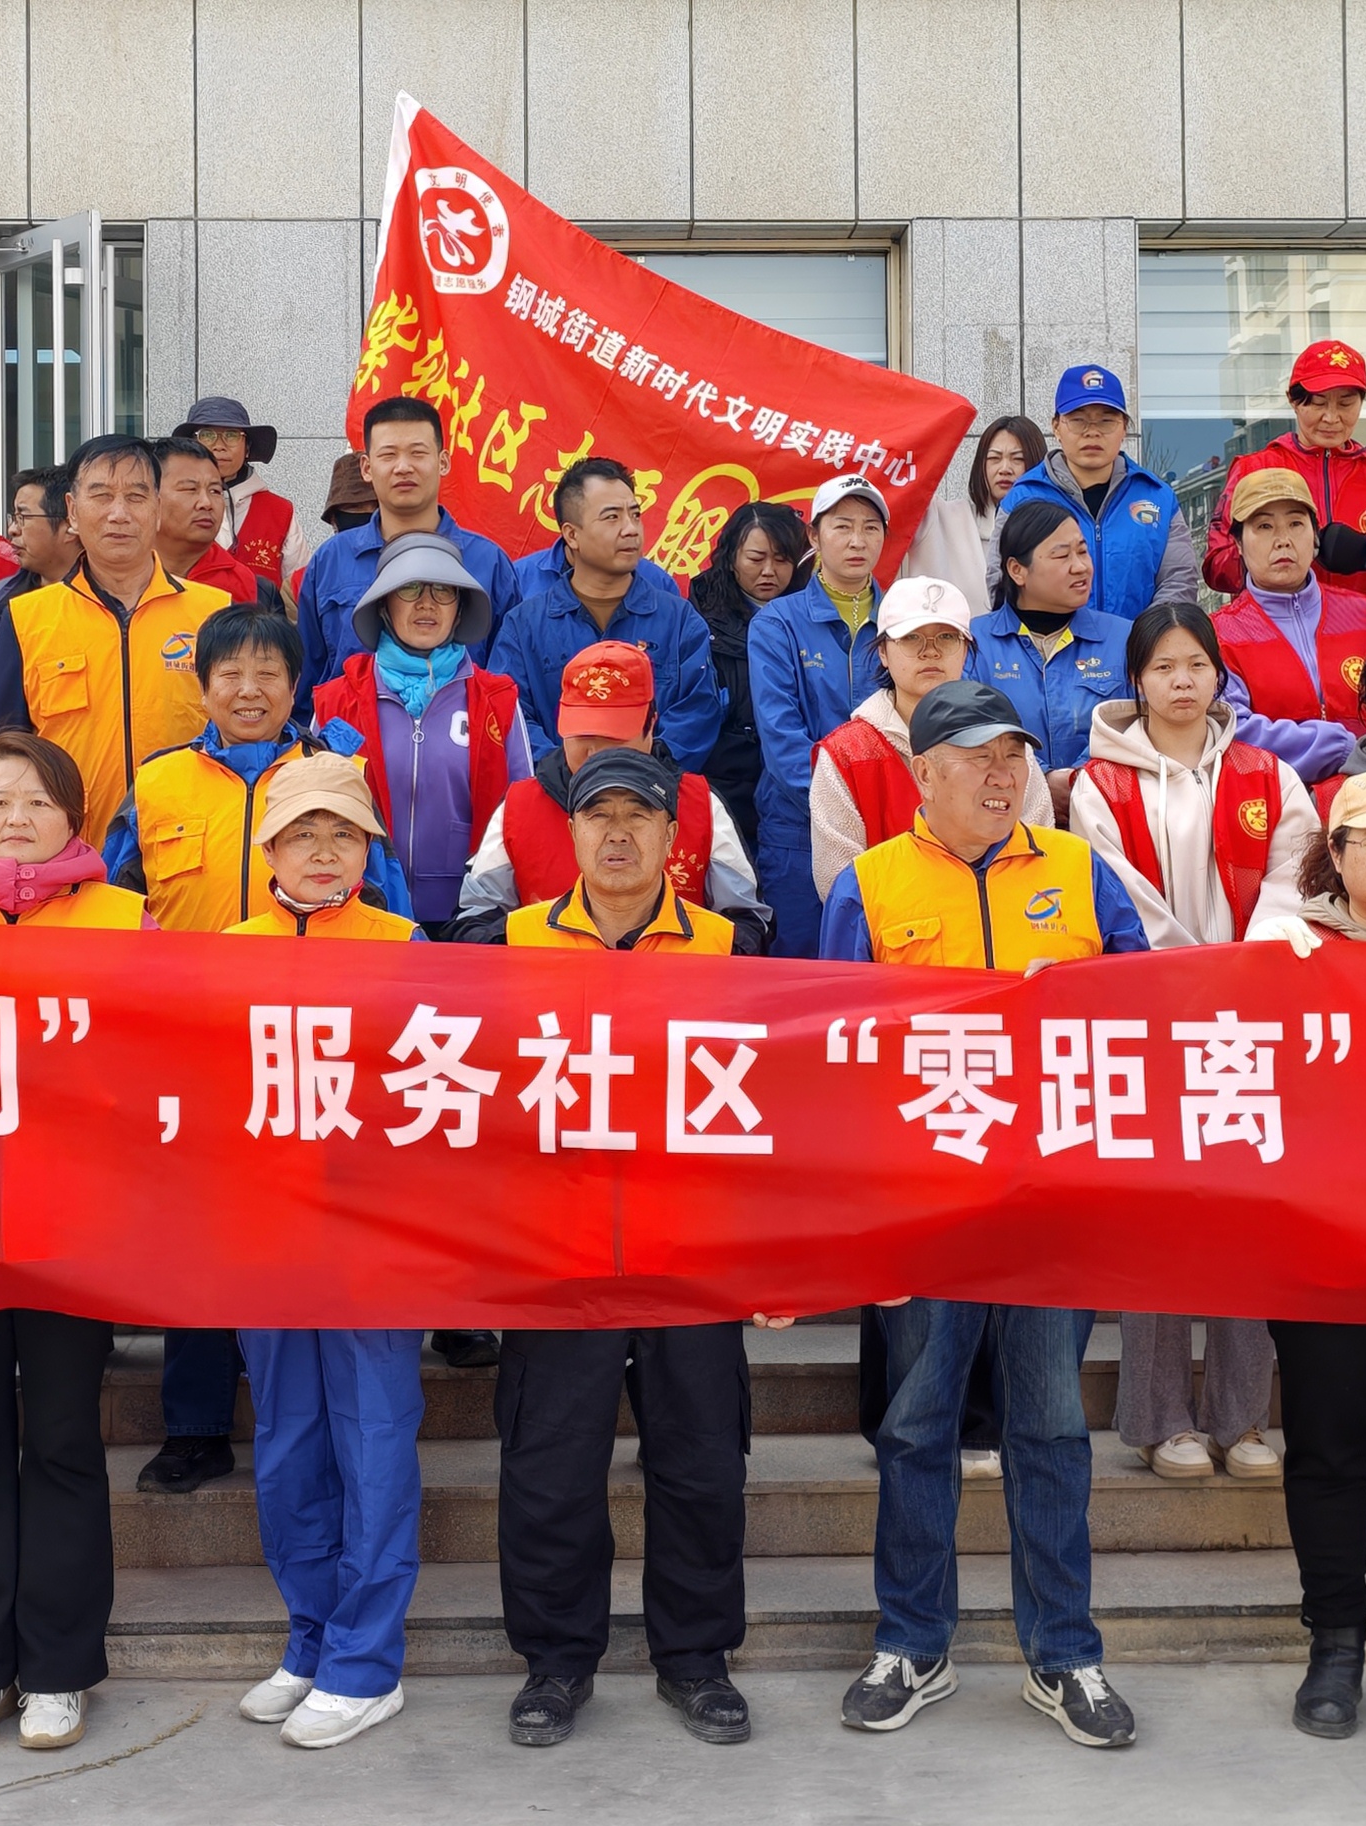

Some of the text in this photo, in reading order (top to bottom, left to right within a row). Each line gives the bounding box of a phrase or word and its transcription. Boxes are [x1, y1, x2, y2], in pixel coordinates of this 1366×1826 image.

[503, 271, 919, 488] 钢城街道新时代文明实践中心
